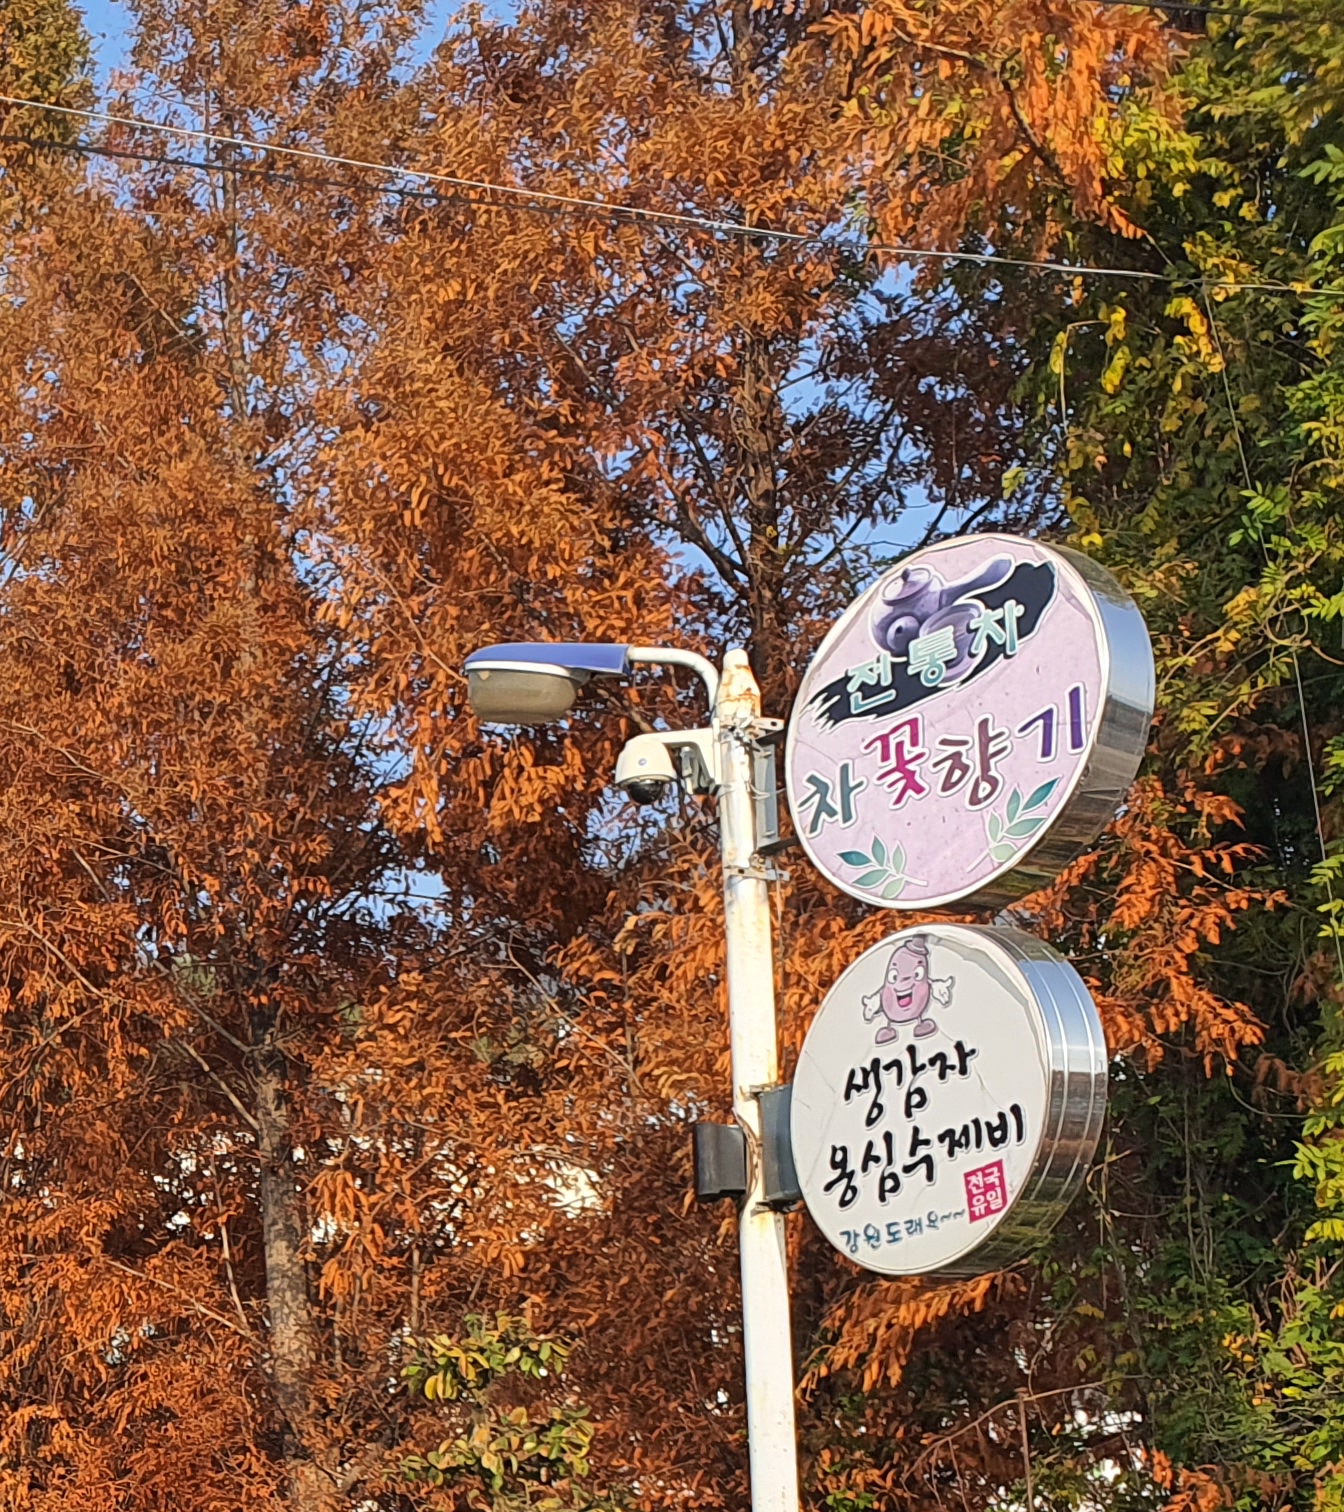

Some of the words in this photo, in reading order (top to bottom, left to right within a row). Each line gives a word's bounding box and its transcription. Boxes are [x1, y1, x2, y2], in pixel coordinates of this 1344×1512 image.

[846, 599, 1025, 713] 전통차
[844, 1040, 976, 1127] 생감자
[823, 1103, 1024, 1208] 옹심수제비
[967, 1166, 1001, 1195] 전국
[970, 1189, 1003, 1217] 유일
